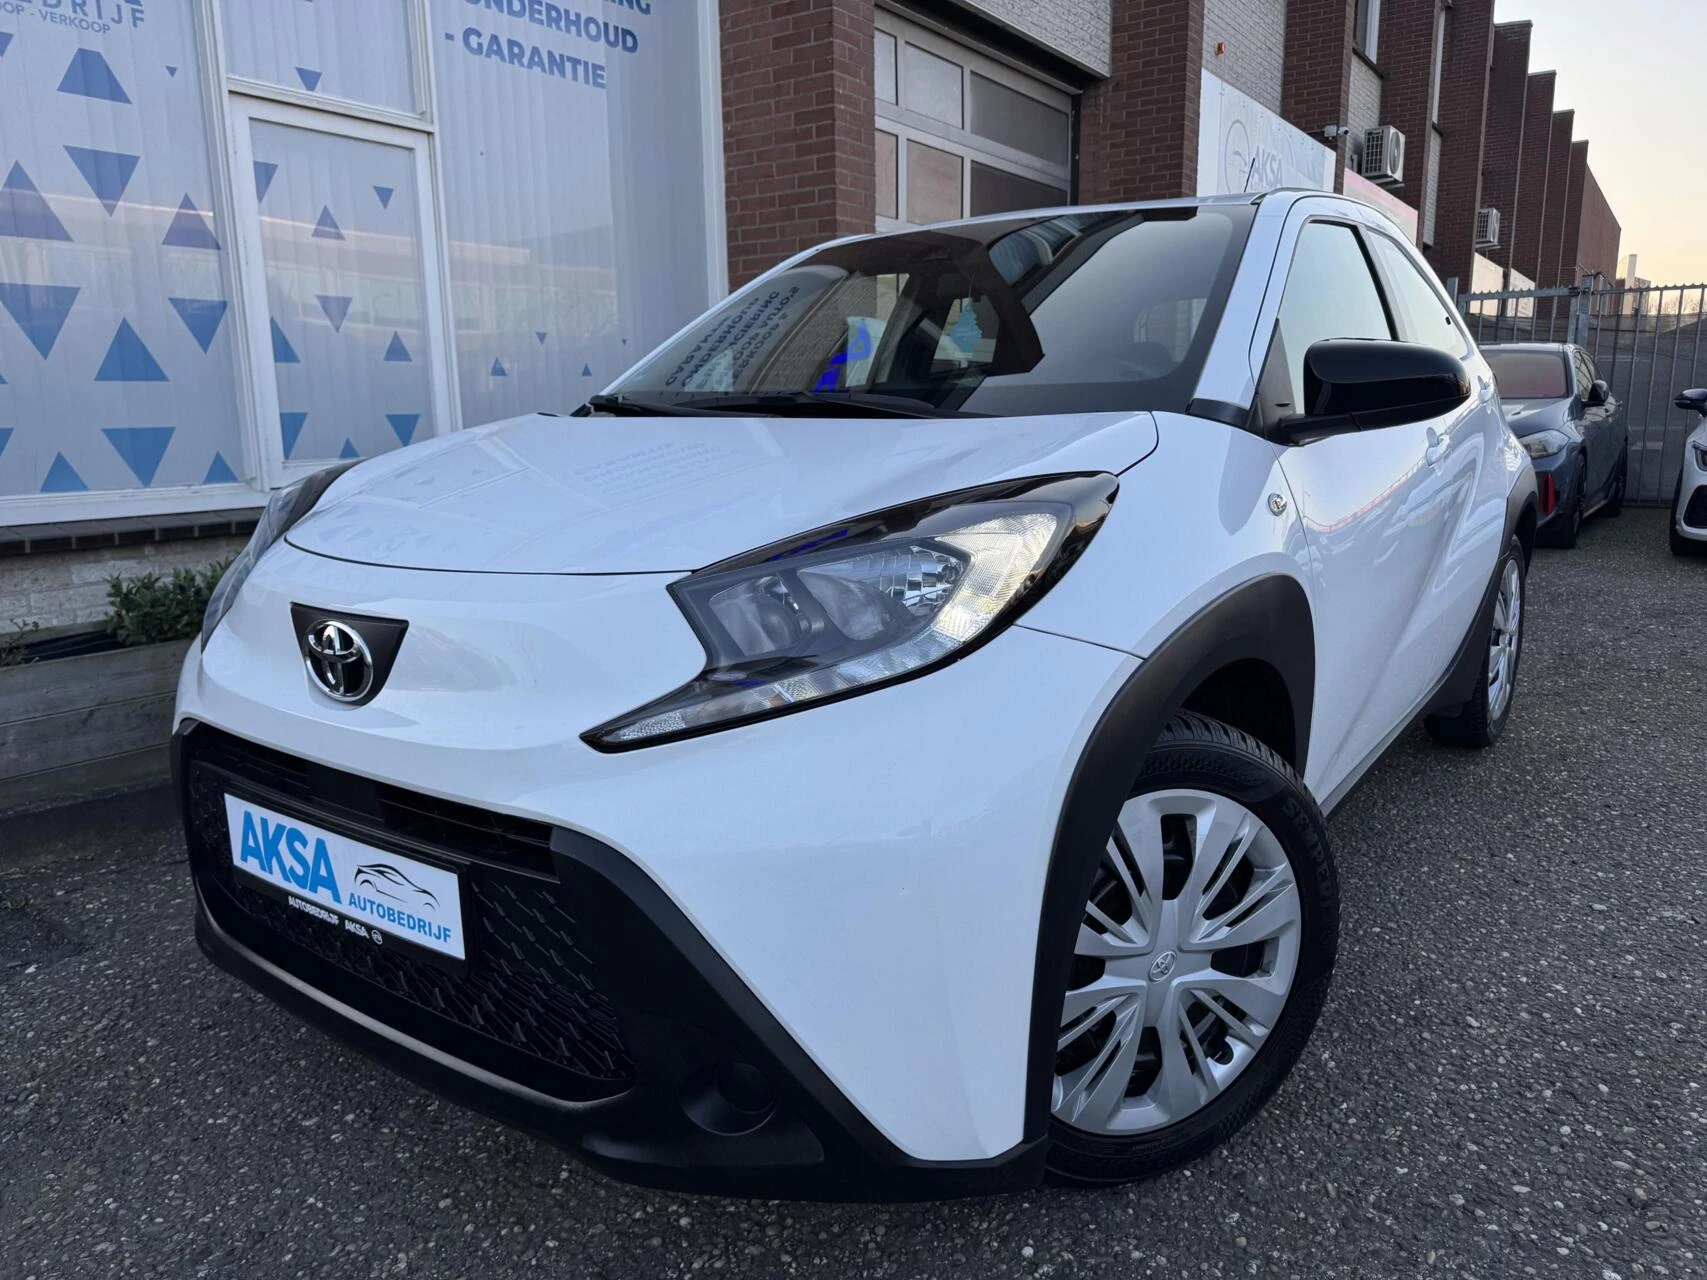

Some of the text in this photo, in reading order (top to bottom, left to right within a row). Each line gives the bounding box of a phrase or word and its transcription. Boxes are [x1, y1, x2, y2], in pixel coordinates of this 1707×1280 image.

[39, 9, 111, 34] VERKOOP
[463, 27, 606, 89] GARANTIE
[1251, 144, 1284, 188] AKSA
[240, 810, 343, 905] AKSA
[344, 919, 370, 939] AKSA
[348, 892, 452, 944] AUTOBEDRIJF
